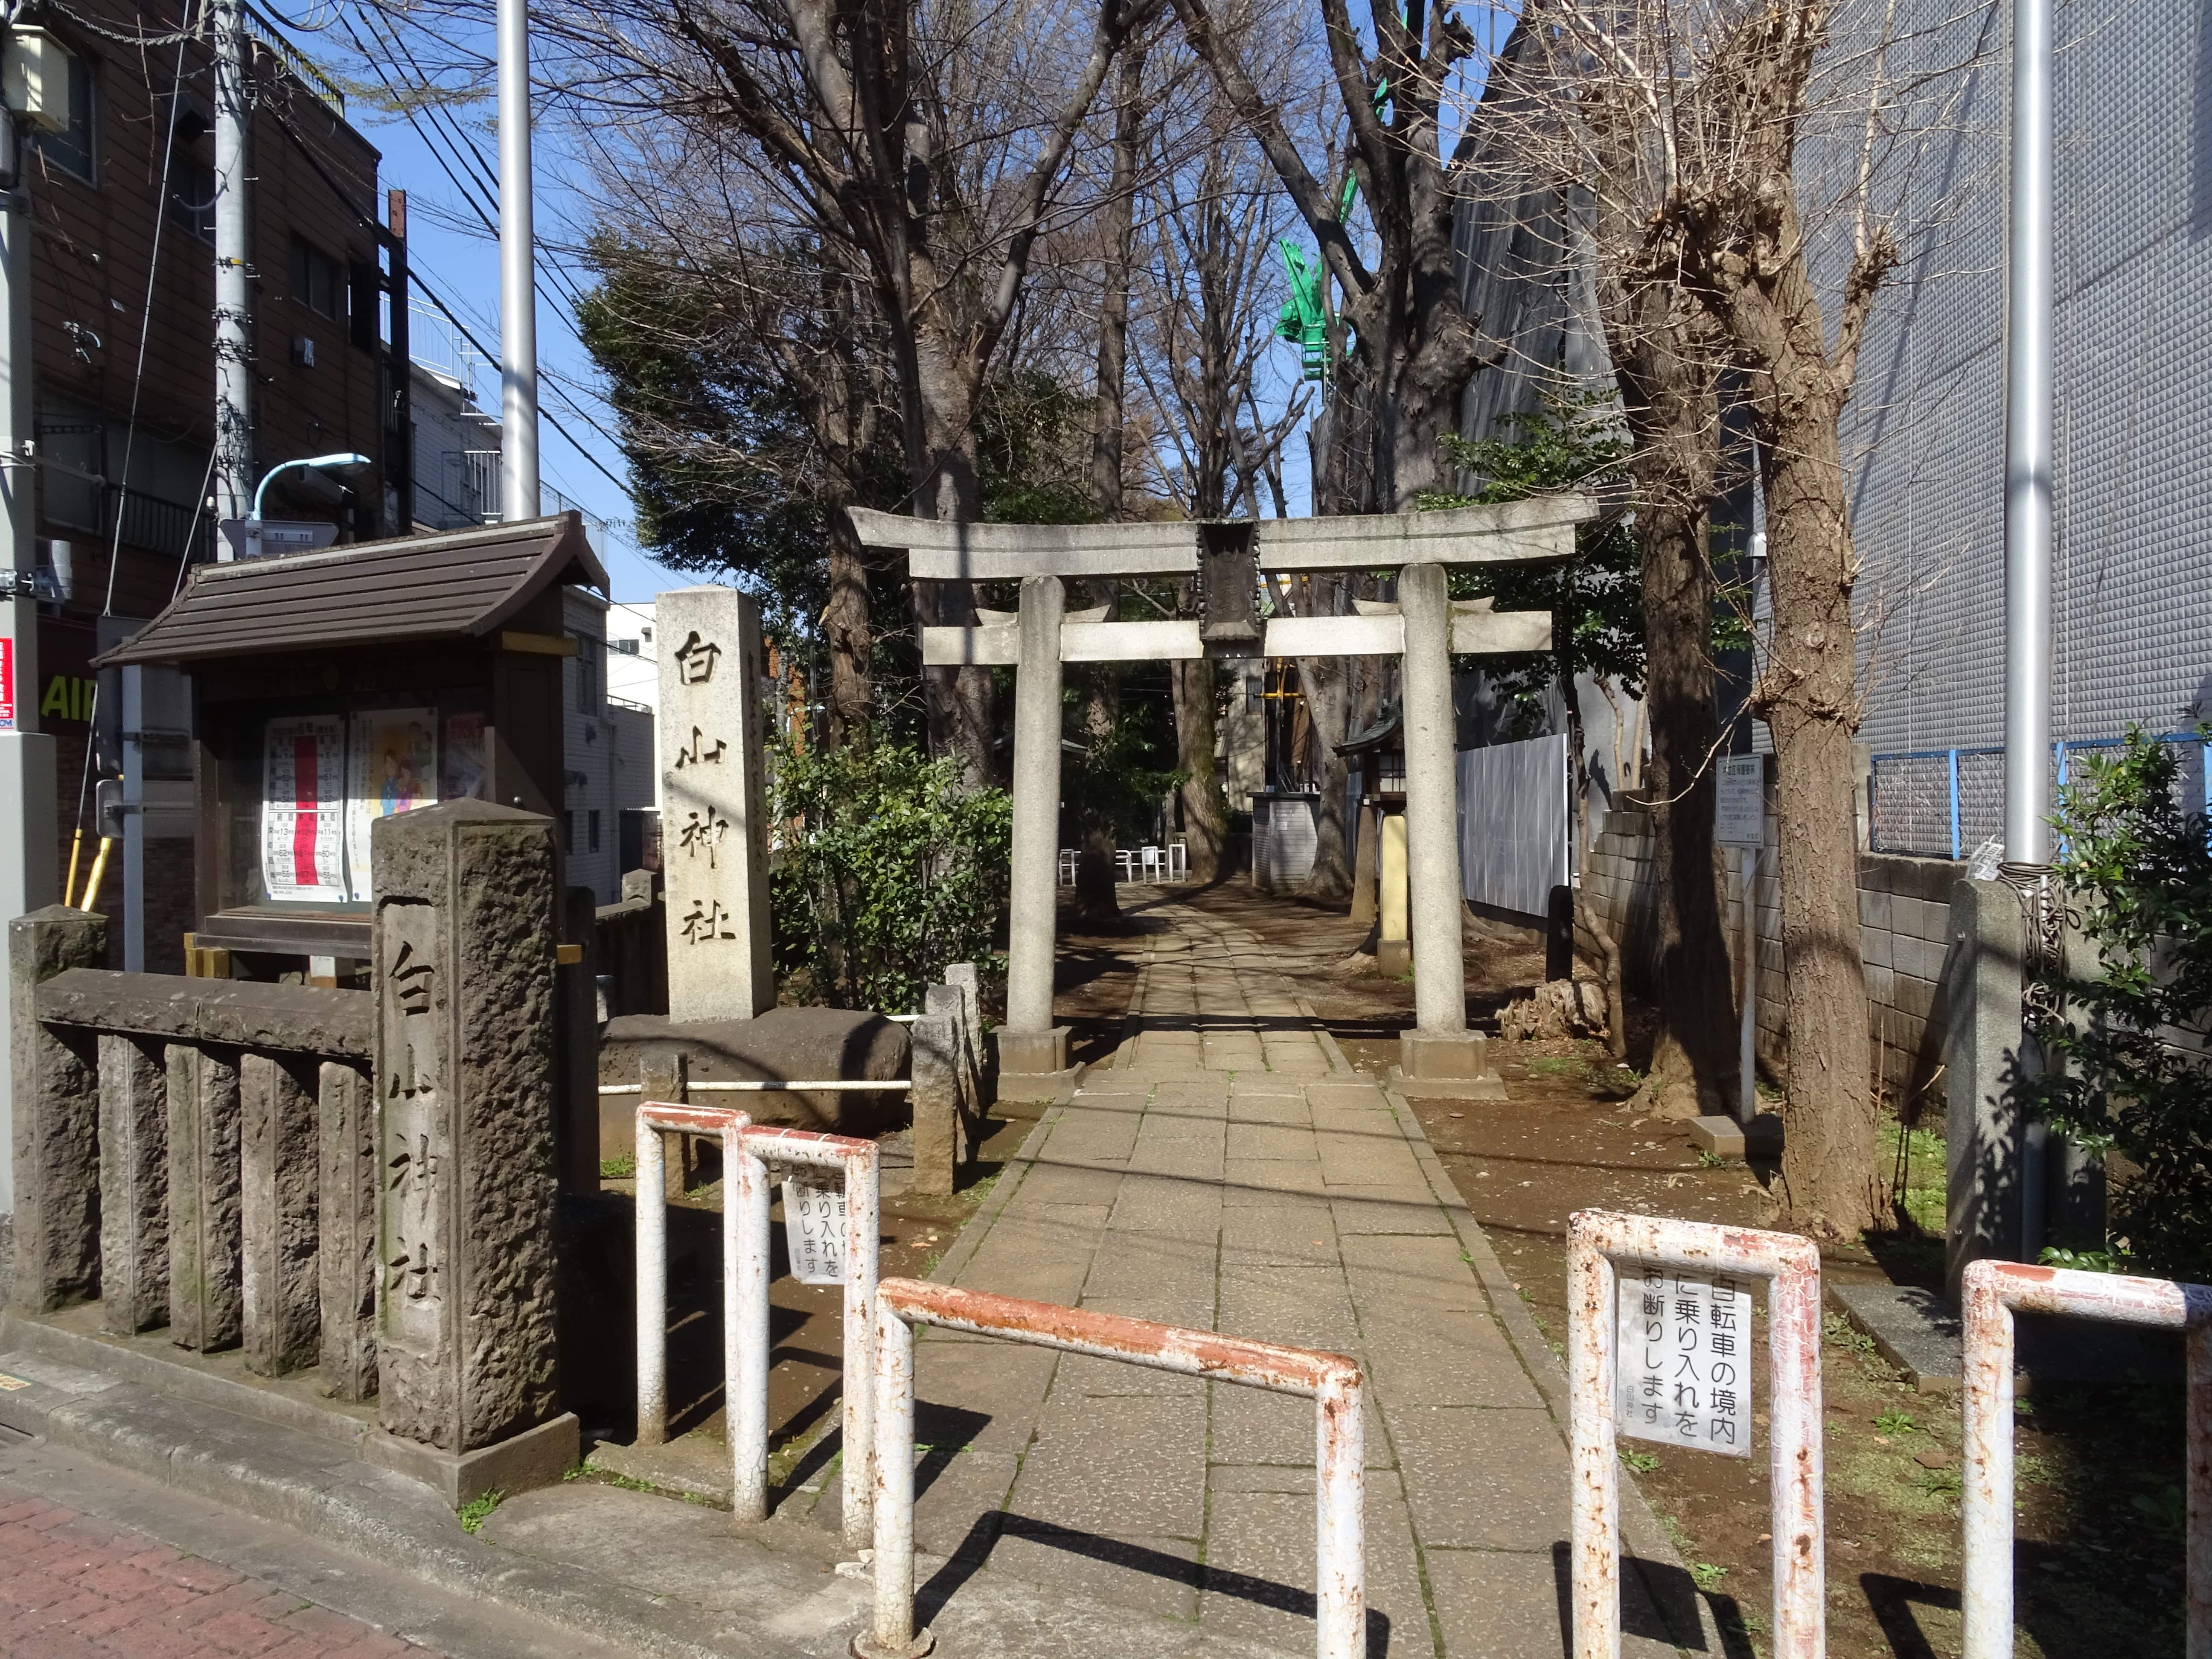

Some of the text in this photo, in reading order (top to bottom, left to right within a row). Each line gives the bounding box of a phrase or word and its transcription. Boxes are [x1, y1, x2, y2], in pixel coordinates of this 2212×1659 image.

[675, 631, 736, 945] 白山神社
[389, 940, 441, 1304] 白山神社
[792, 1164, 818, 1273] お断りします
[813, 1165, 838, 1277] に乗り入れを
[1641, 1268, 1665, 1424] お断りします
[1674, 1273, 1700, 1438] に乗り入れを
[1710, 1274, 1737, 1445] 自転車の境内
